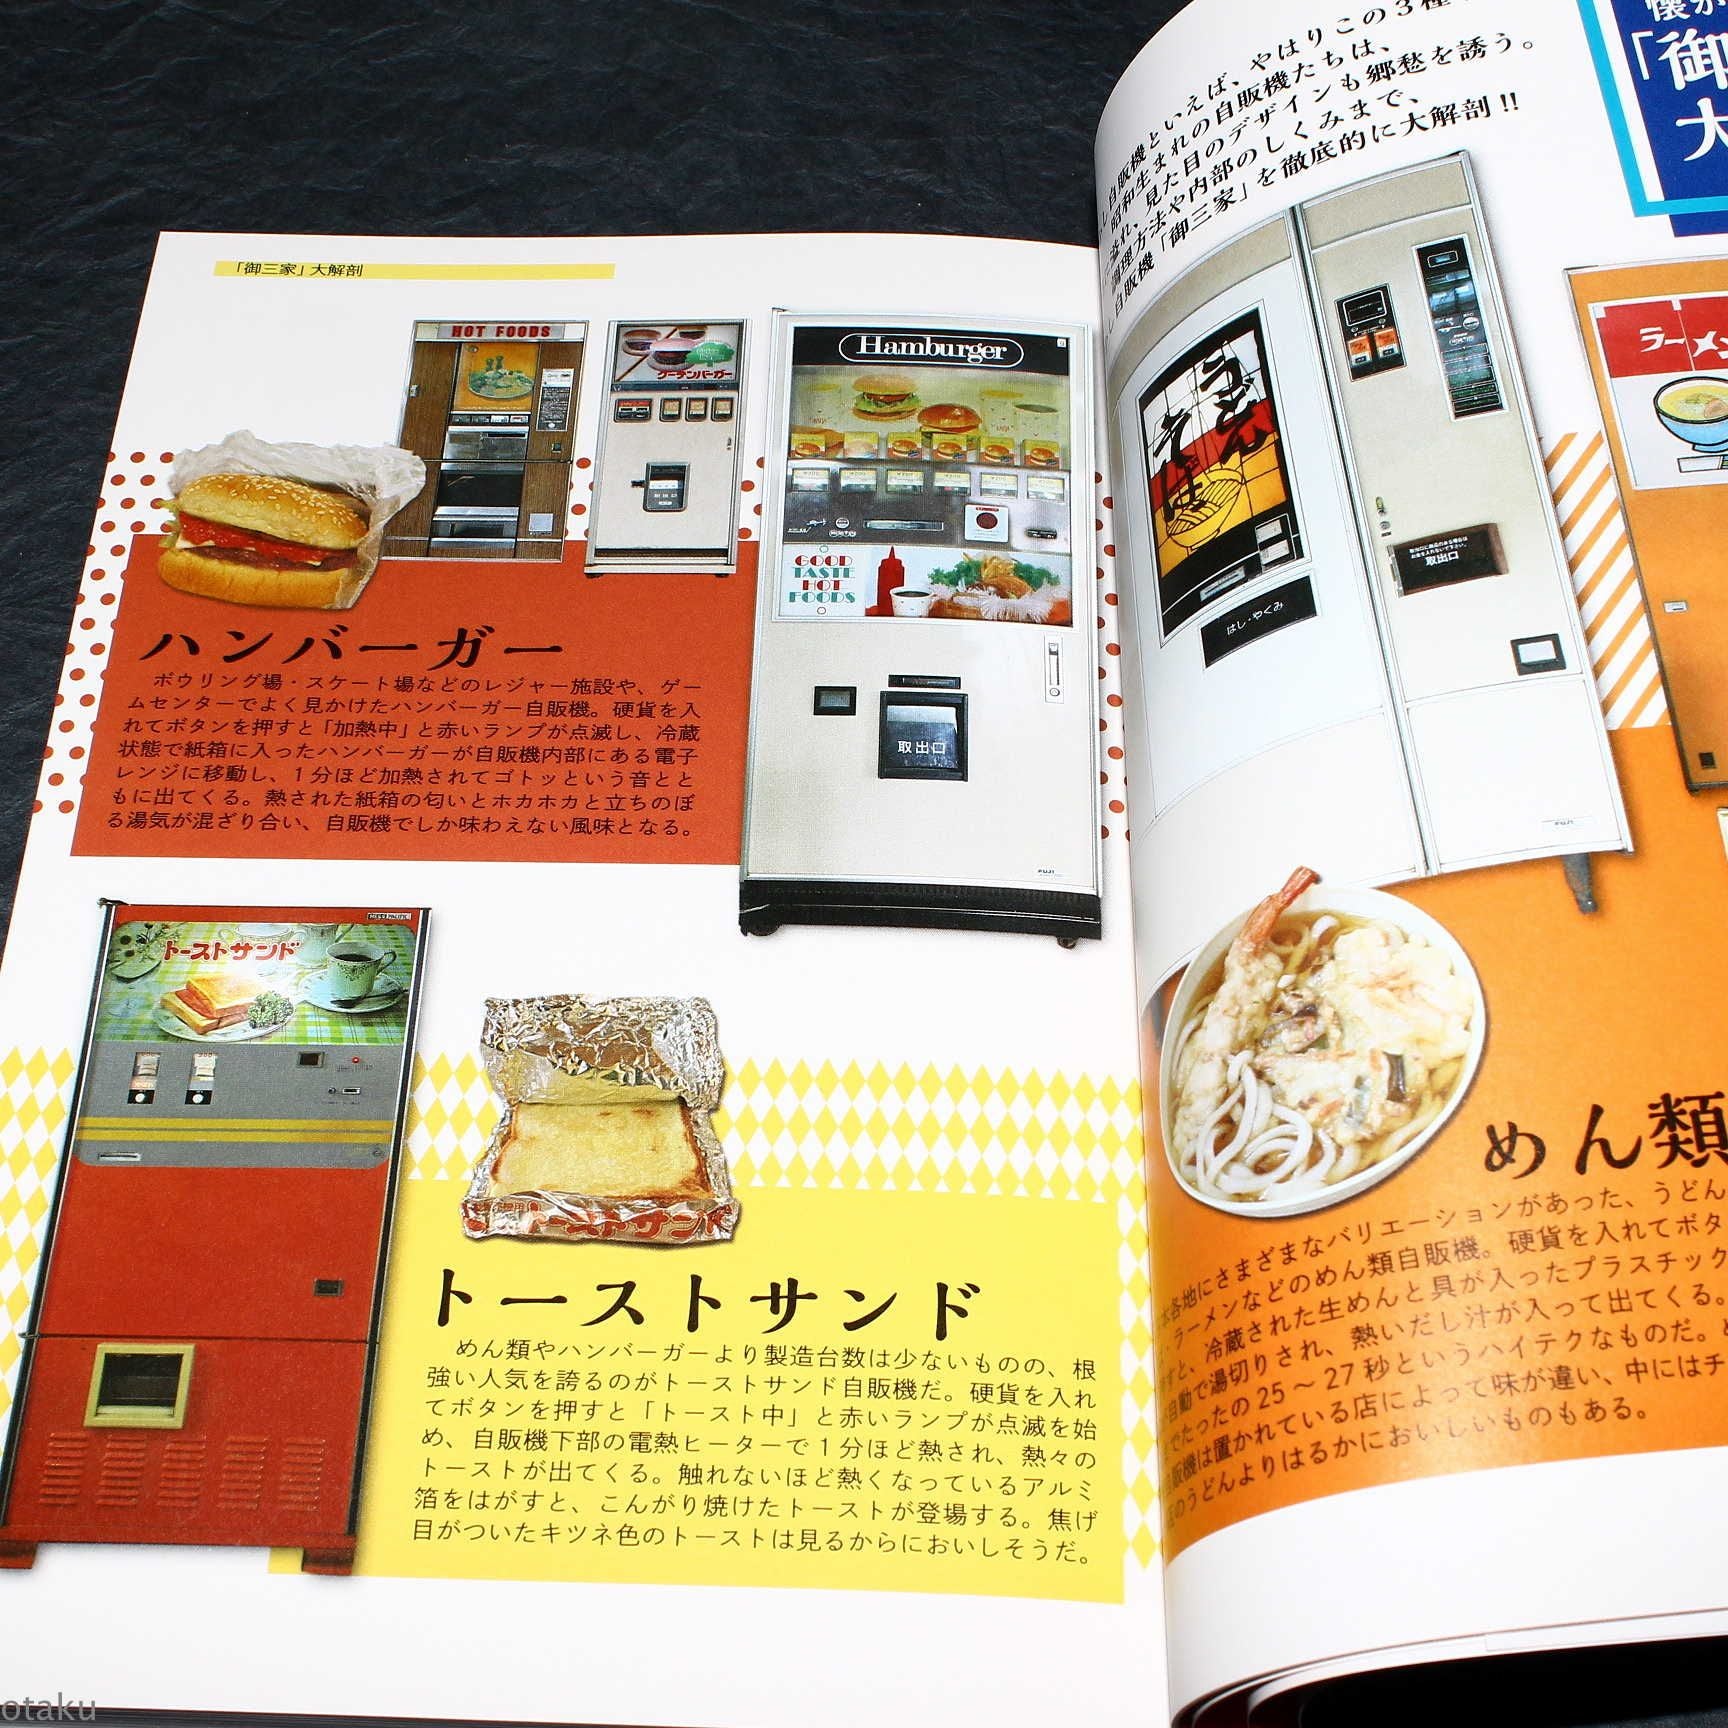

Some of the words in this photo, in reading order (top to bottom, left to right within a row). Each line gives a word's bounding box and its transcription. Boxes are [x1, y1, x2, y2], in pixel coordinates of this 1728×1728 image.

[236, 261, 363, 278] 「御三家」大解剖
[451, 325, 486, 338] HOT
[495, 325, 552, 338] FOODS
[855, 334, 1008, 364] Hamburger
[794, 555, 853, 567] GOOD
[1425, 551, 1460, 567] 取出口
[791, 567, 855, 579] TASTE
[802, 579, 850, 592] HOT
[788, 591, 856, 604] FOODS
[139, 624, 563, 671] ハンバーガー
[897, 740, 947, 755] 取出口
[163, 940, 301, 961] トーストサンド
[1484, 1091, 1728, 1180] めん類
[437, 1268, 981, 1341] トーストサンド
